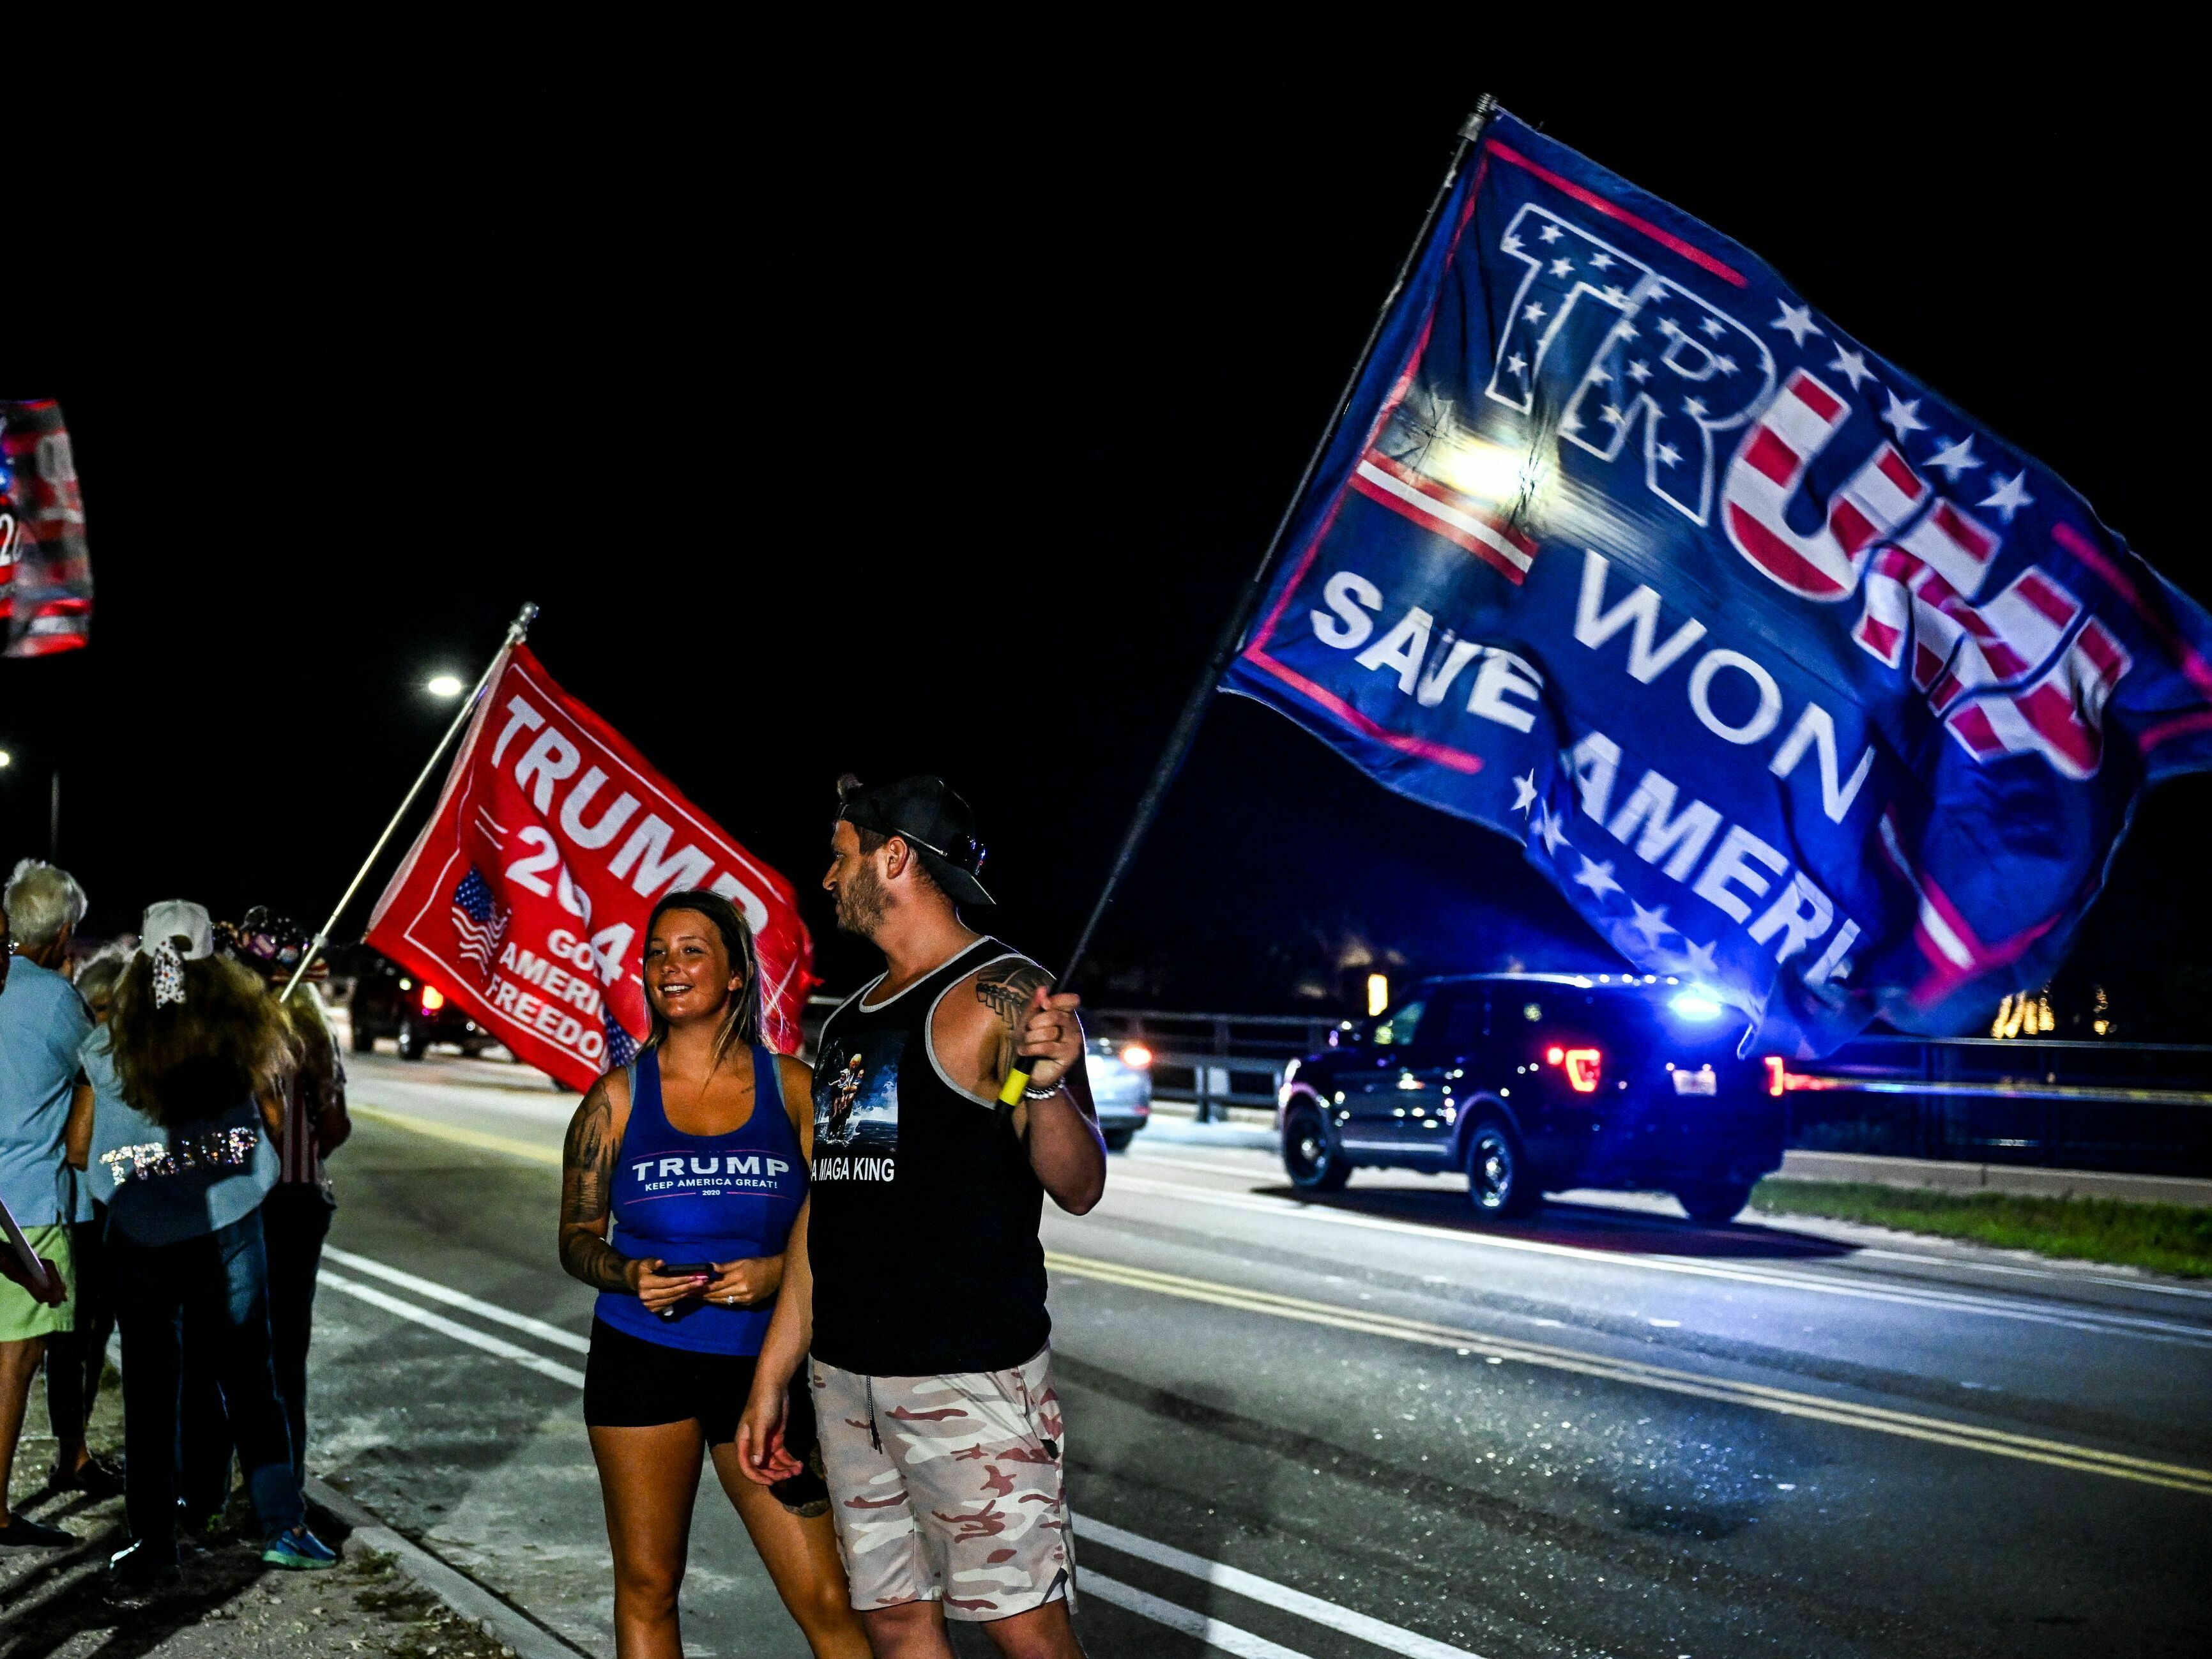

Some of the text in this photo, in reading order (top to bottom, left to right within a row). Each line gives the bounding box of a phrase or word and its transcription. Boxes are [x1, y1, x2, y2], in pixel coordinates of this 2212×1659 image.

[1485, 203, 2133, 781] TRUMP
[1573, 548, 1877, 825] WON
[1309, 570, 1863, 986] SAVE AMERI
[499, 942, 607, 1025] AMERI
[547, 928, 599, 979] GO
[485, 974, 610, 1071] FREEDO
[632, 1156, 790, 1181] TRUMP
[645, 1178, 778, 1191] KEEP AMERICA GREAT!
[819, 1157, 850, 1181] MAGA
[853, 1157, 895, 1182] KING
